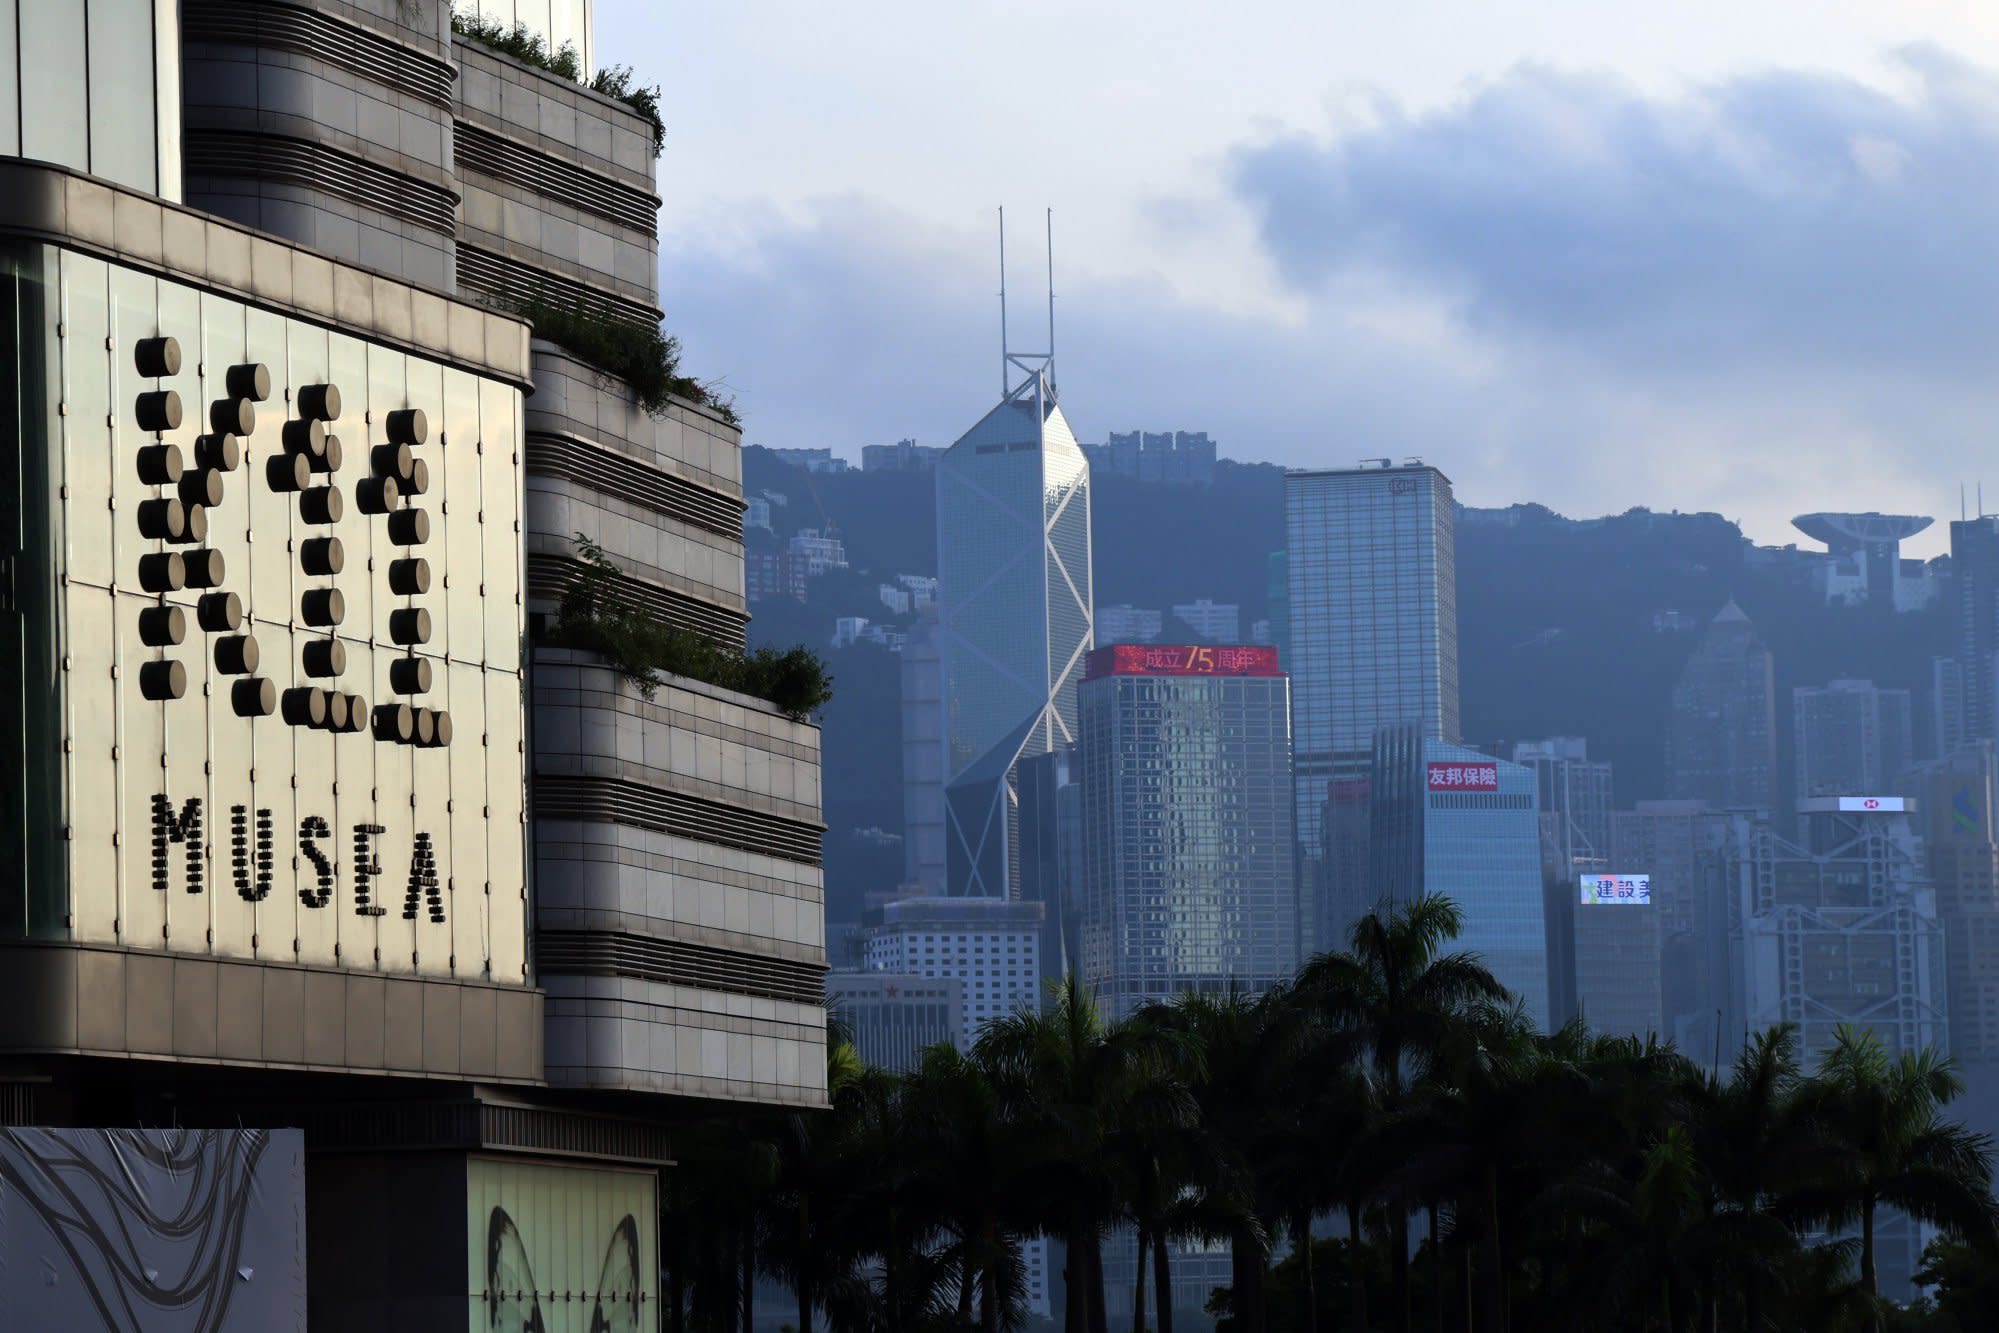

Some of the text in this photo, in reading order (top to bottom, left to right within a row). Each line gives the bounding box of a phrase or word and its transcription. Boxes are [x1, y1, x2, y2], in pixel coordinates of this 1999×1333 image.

[135, 336, 453, 748] K11
[1429, 767, 1496, 785] 友邦保險
[151, 793, 446, 923] MUSEA
